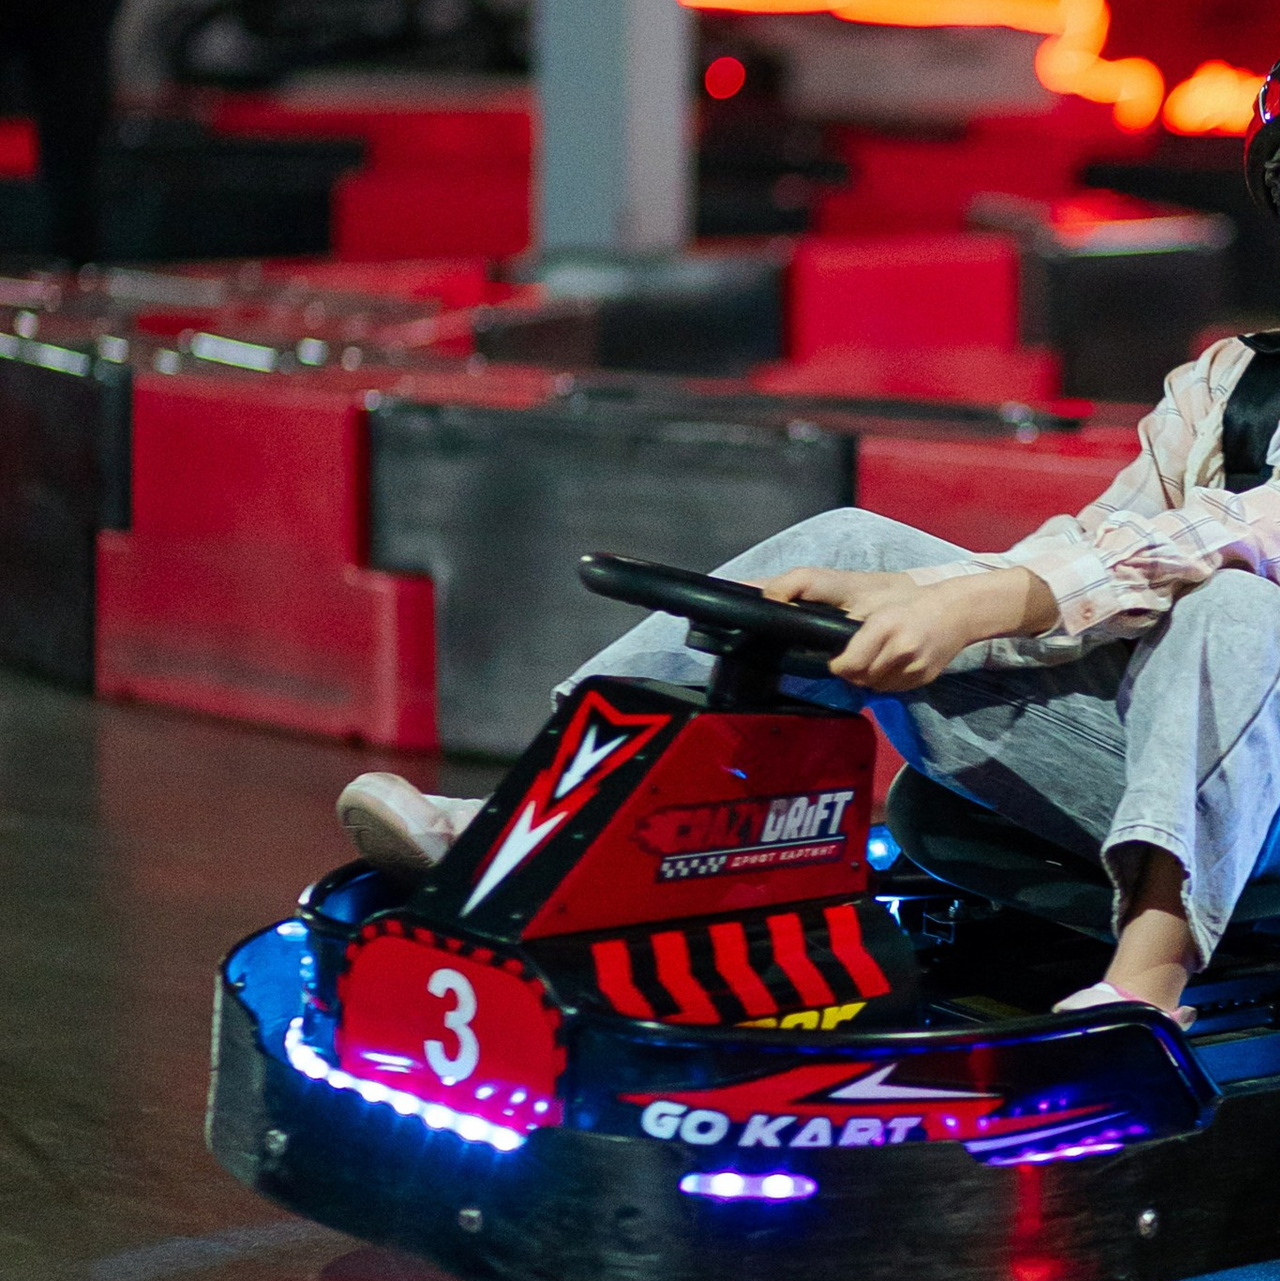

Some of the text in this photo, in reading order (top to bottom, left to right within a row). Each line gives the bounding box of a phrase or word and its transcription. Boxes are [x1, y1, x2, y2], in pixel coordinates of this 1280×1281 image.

[423, 967, 480, 1086] 3
[641, 1100, 923, 1148] GO KART
